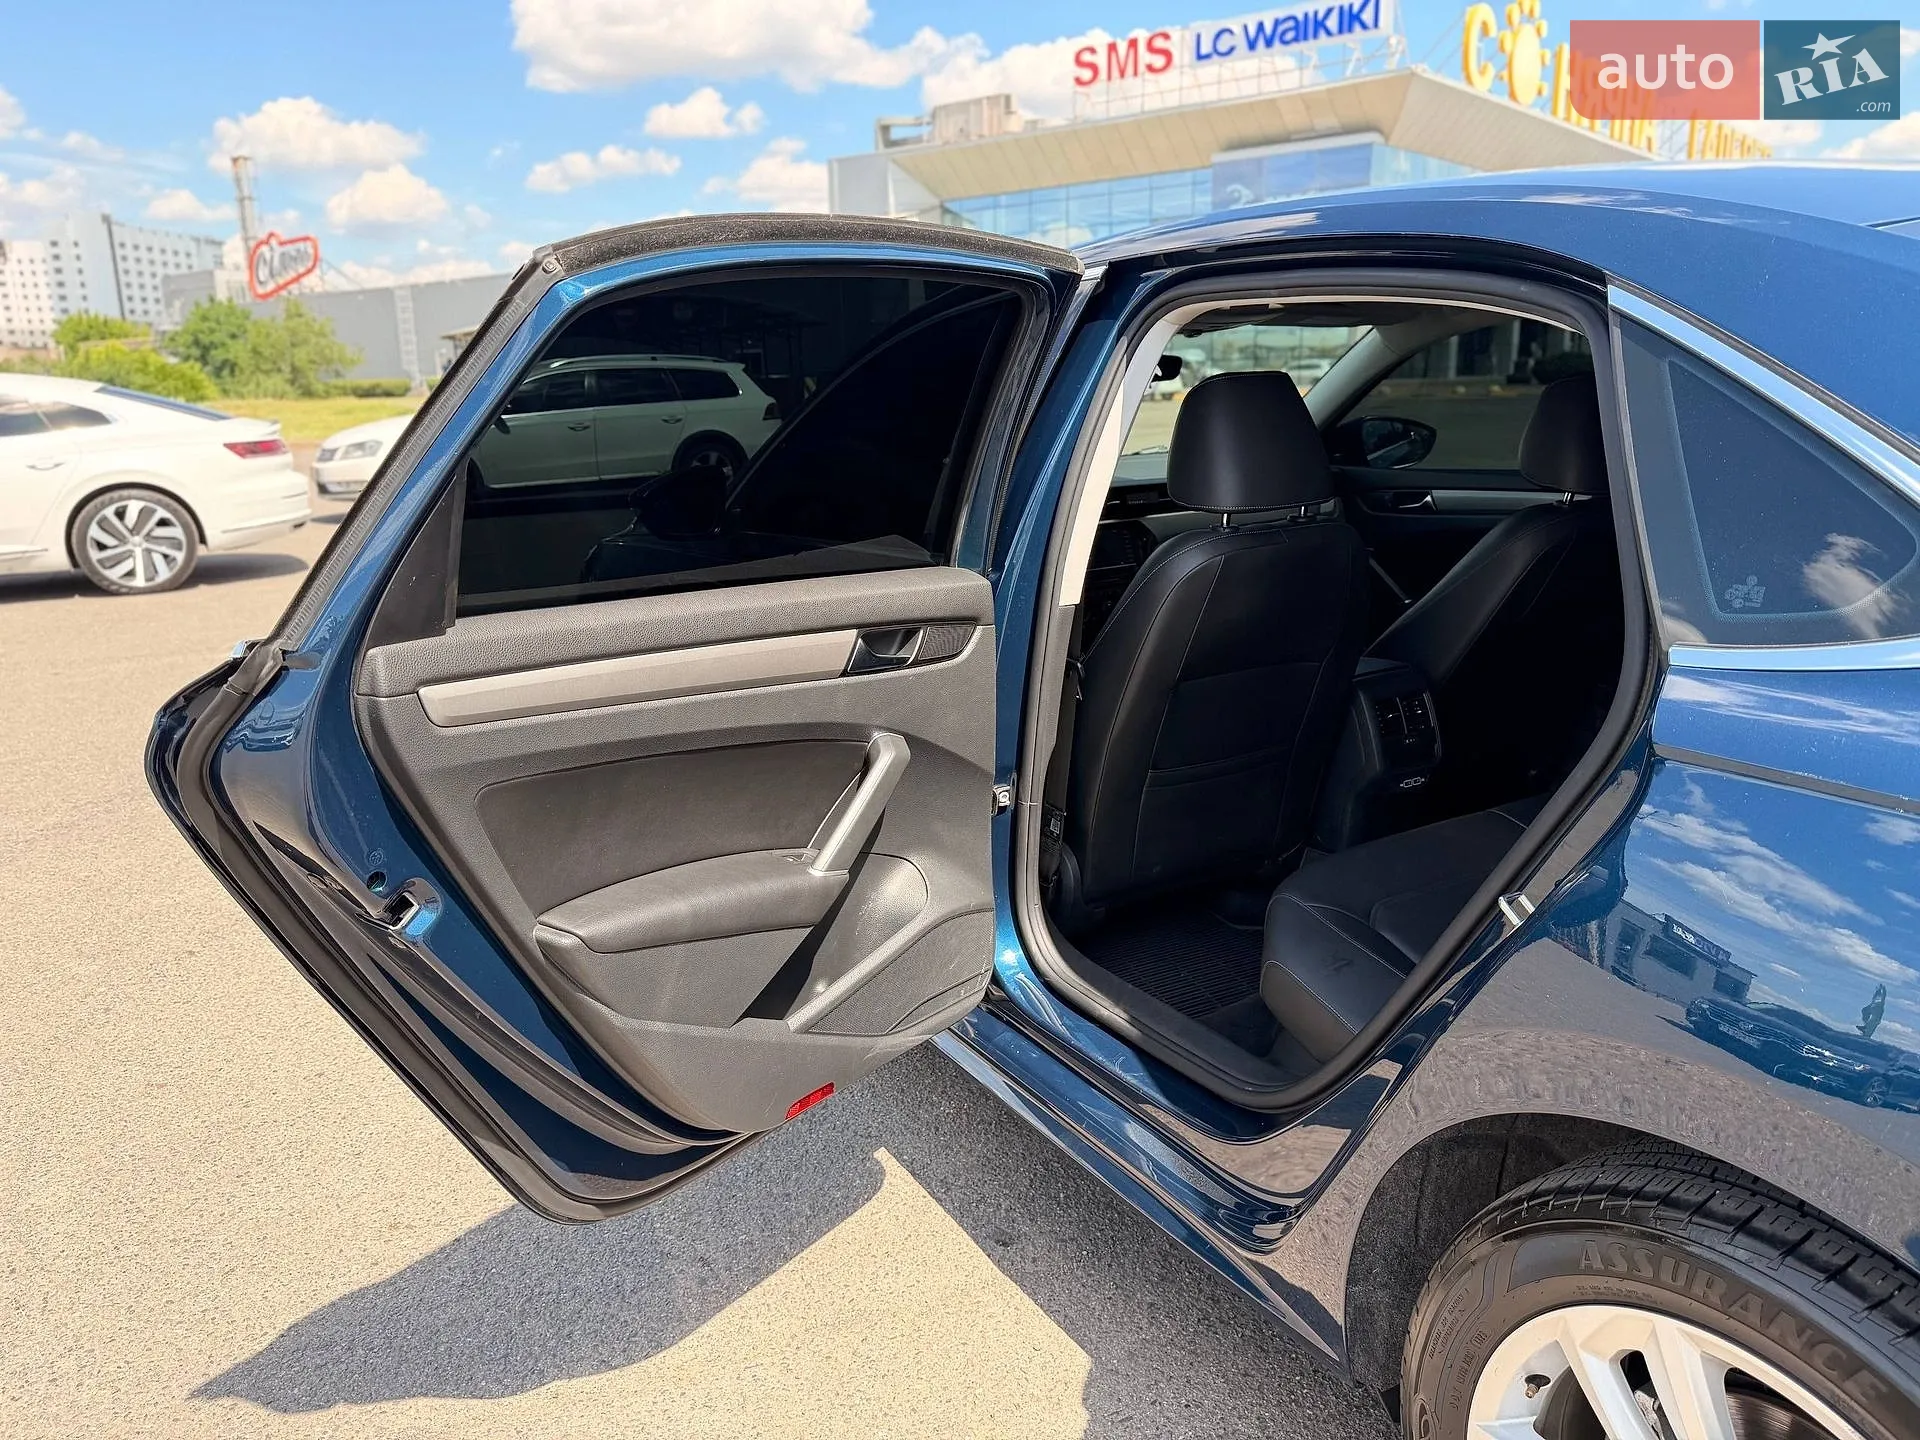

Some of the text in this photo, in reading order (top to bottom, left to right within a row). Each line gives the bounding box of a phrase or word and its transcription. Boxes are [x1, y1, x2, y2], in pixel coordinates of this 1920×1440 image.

[1073, 31, 1174, 87] SMS
[1195, 27, 1237, 62] LC
[1578, 1238, 1888, 1404] ASSURANCE
